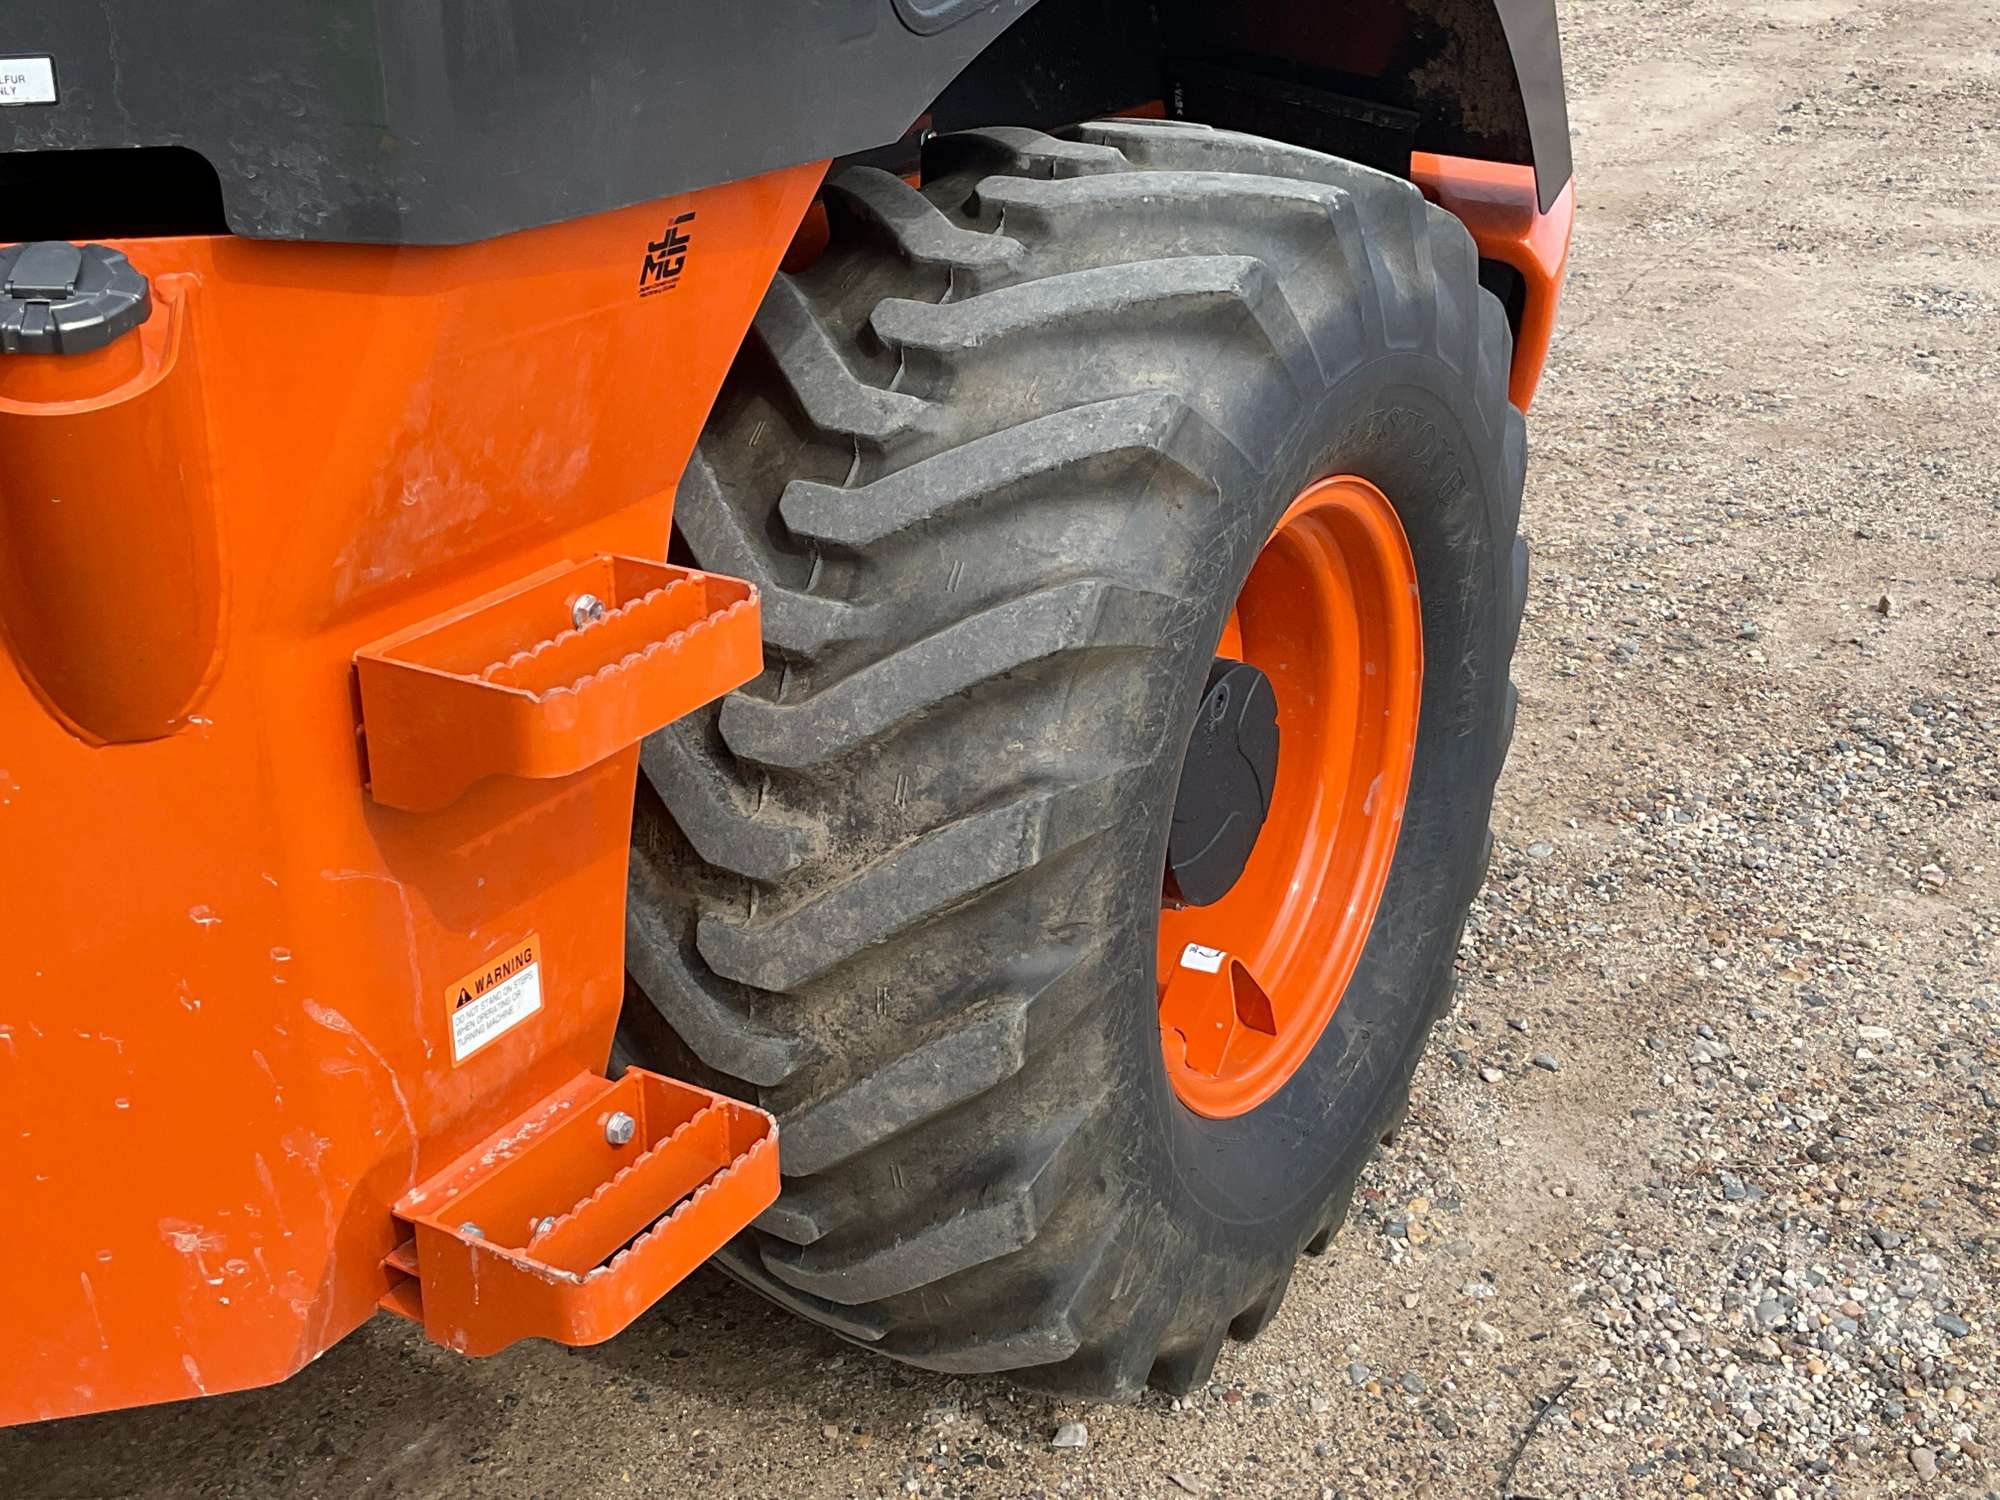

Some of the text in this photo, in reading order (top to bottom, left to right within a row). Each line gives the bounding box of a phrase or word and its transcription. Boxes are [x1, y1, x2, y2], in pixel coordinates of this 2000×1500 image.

[475, 948, 532, 993] WARNING
[455, 969, 533, 1027] DO NOT STAND ON STEPS
[456, 988, 521, 1037] WHEN OPERATING OR
[457, 1006, 513, 1048] TURNING MACHINE
